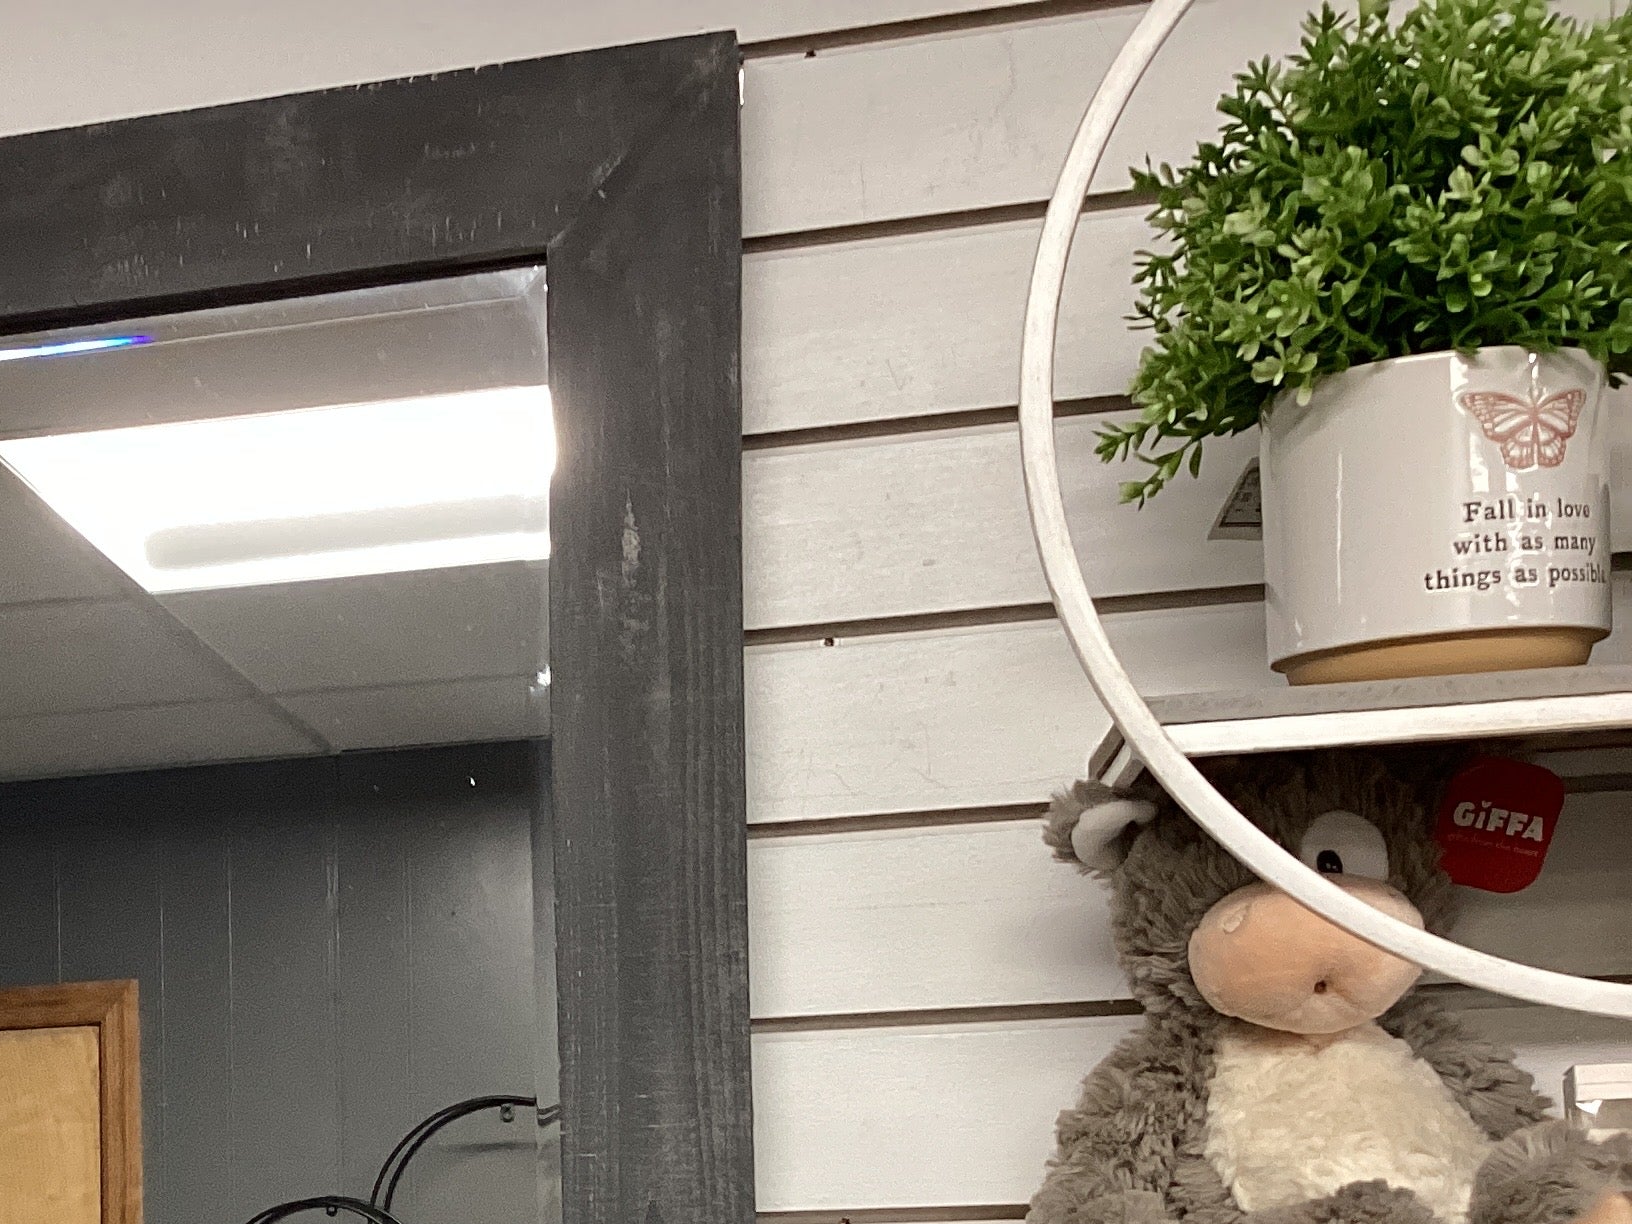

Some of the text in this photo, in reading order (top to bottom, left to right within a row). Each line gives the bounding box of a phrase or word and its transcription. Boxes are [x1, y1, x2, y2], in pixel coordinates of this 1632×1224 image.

[1463, 497, 1590, 522] Fall in love
[1453, 532, 1595, 556] with as many
[1424, 567, 1501, 591] things
[1515, 567, 1537, 582] as
